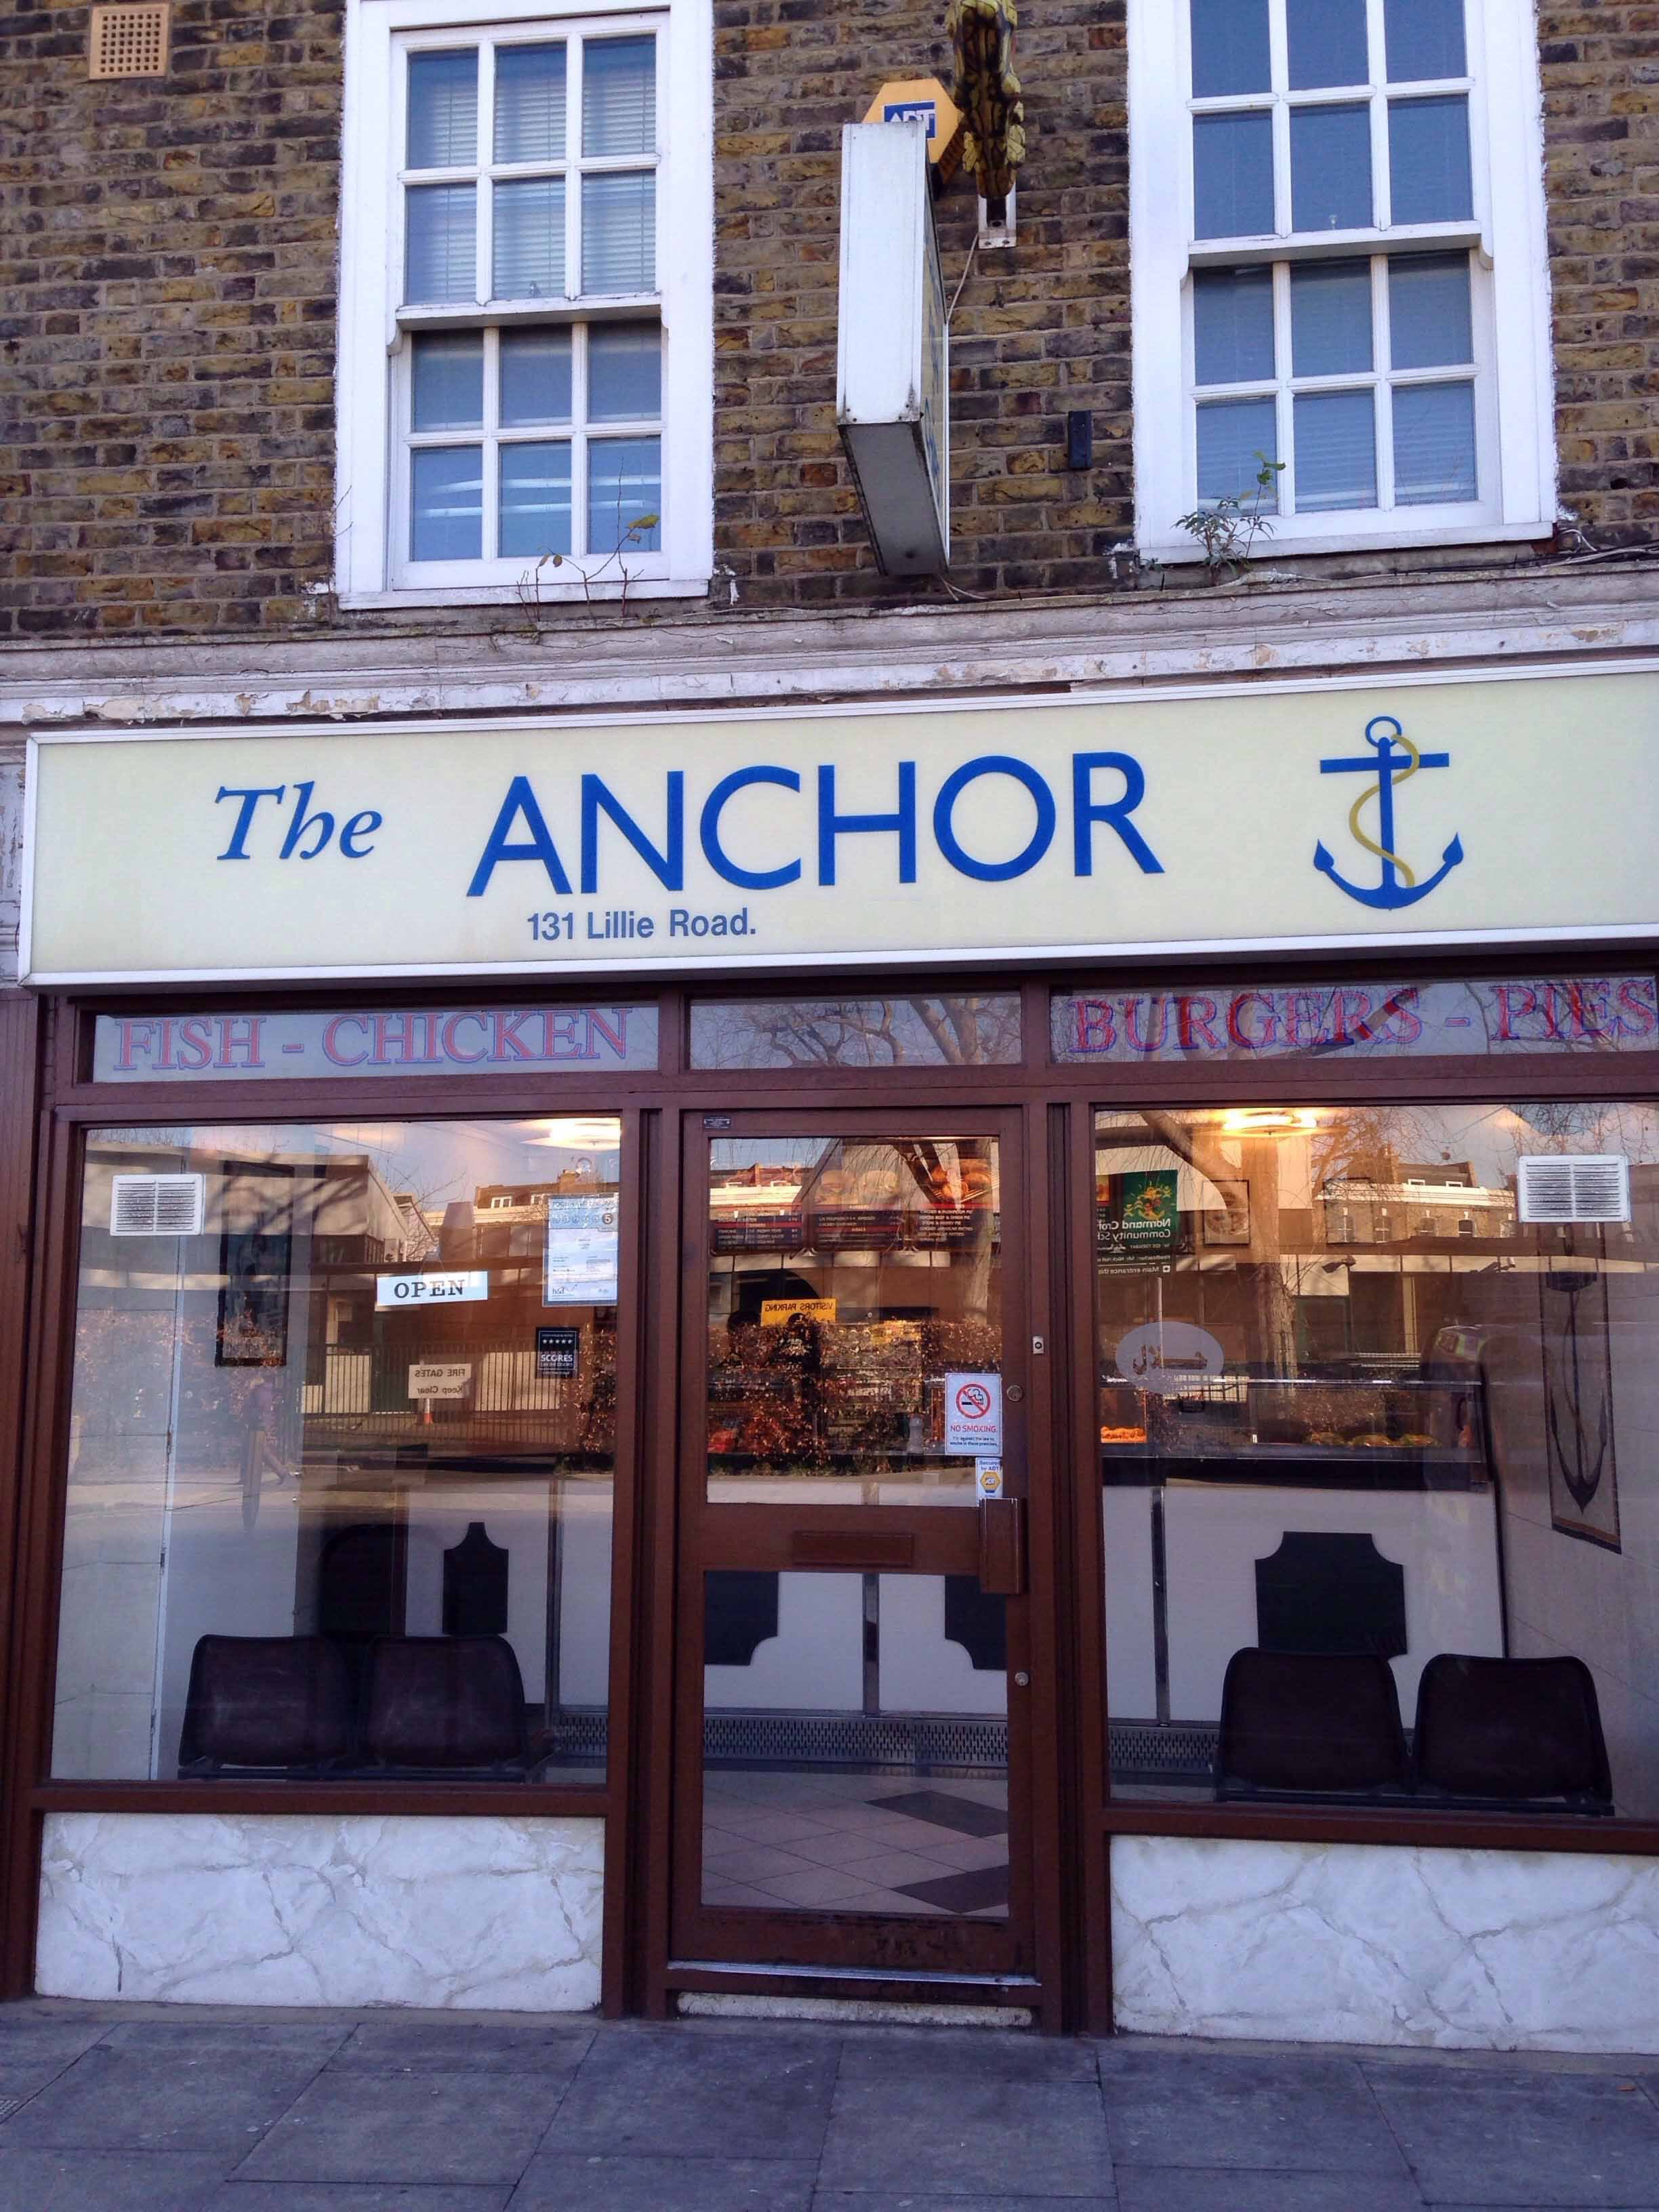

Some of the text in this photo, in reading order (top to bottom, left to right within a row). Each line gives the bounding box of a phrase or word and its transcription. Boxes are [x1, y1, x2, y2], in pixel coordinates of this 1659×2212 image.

[214, 752, 1166, 897] The ANCHOR
[527, 907, 757, 941] 131 Lillie Road.
[114, 1015, 266, 1070] FISH
[322, 1007, 633, 1065] CHICKEN
[1069, 987, 1422, 1053] BURGERS
[1489, 980, 1659, 1041] PIES
[394, 1279, 466, 1299] OPEN
[541, 1354, 573, 1362] SCORES
